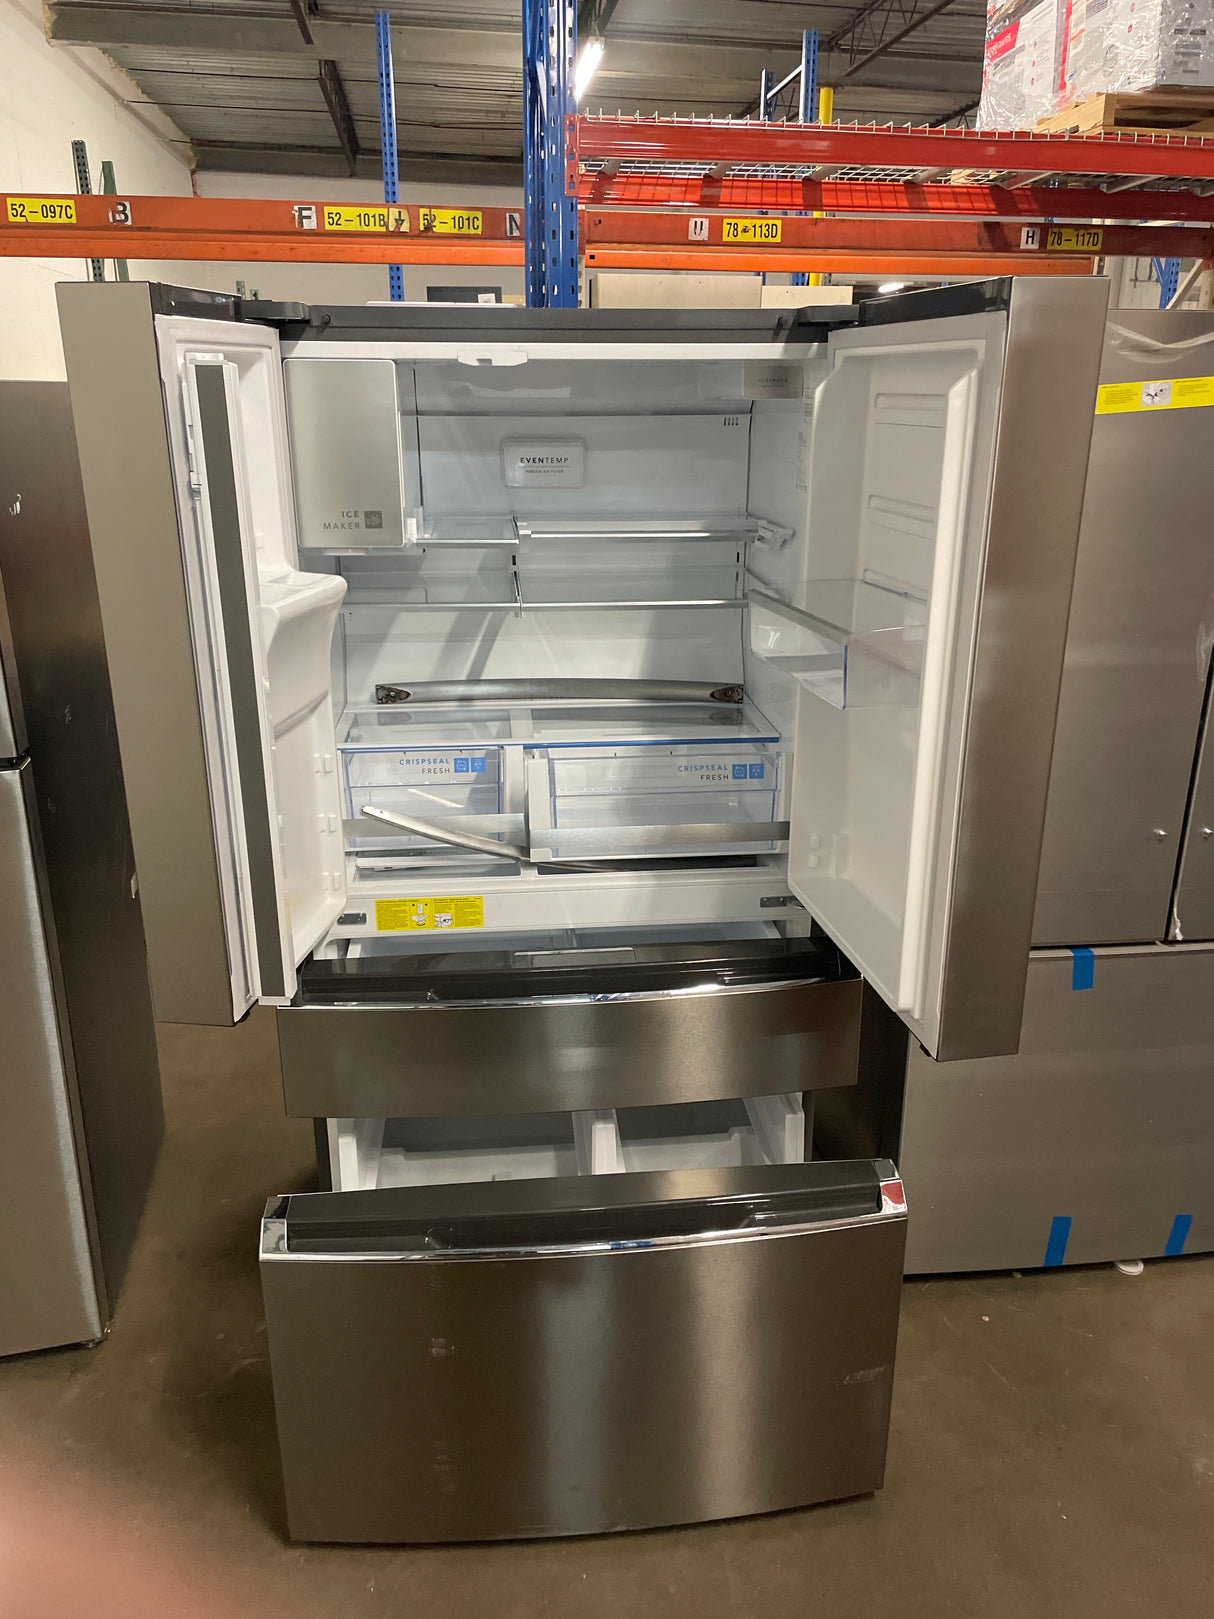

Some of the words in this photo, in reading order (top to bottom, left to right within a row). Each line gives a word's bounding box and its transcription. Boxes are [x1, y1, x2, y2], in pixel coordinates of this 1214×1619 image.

[10, 203, 73, 219] 52-097C
[298, 207, 312, 228] F
[1025, 230, 1035, 245] H
[342, 510, 359, 518] ICE
[323, 522, 360, 530] MAKER
[677, 764, 728, 772] CRISPSEAL
